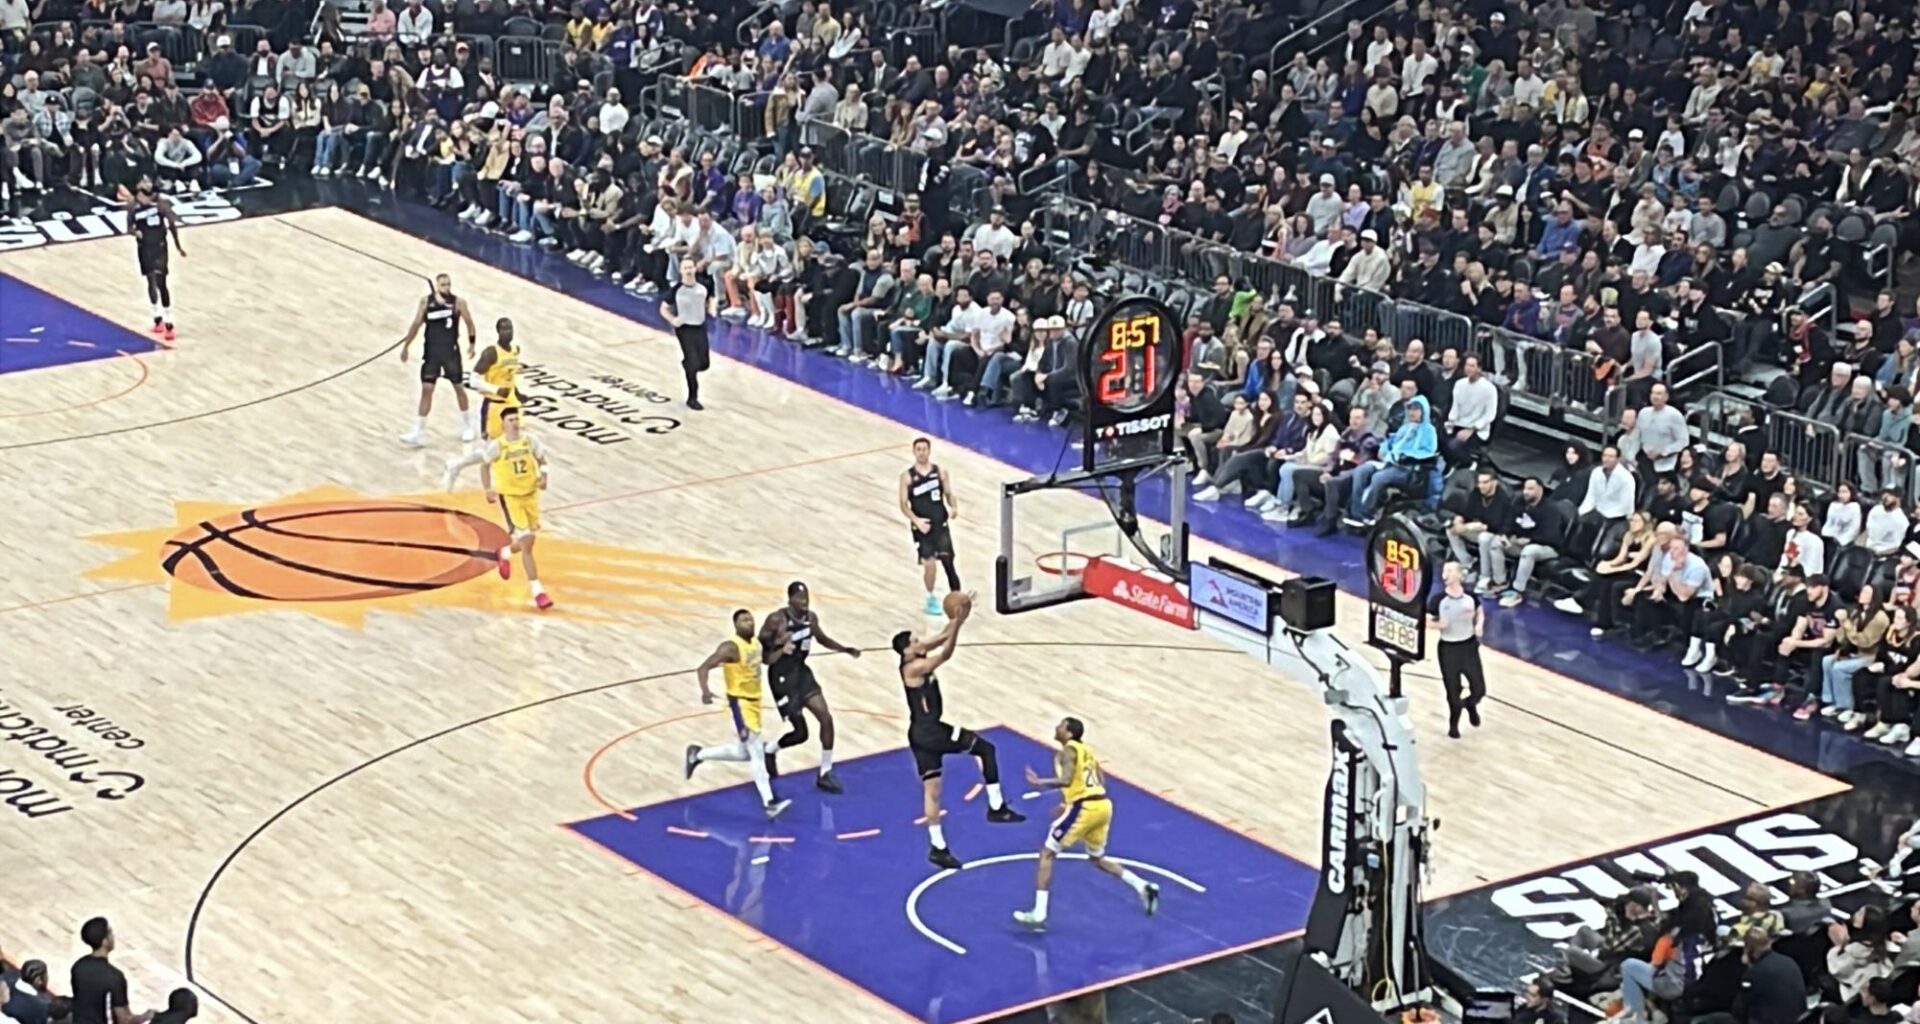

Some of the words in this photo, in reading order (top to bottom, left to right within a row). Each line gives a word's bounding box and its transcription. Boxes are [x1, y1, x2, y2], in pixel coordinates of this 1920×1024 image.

[1111, 315, 1160, 351] 8:57
[1098, 345, 1156, 403] 21
[1115, 413, 1171, 436] TISSOT
[513, 460, 528, 475] 12
[52, 703, 146, 750] center
